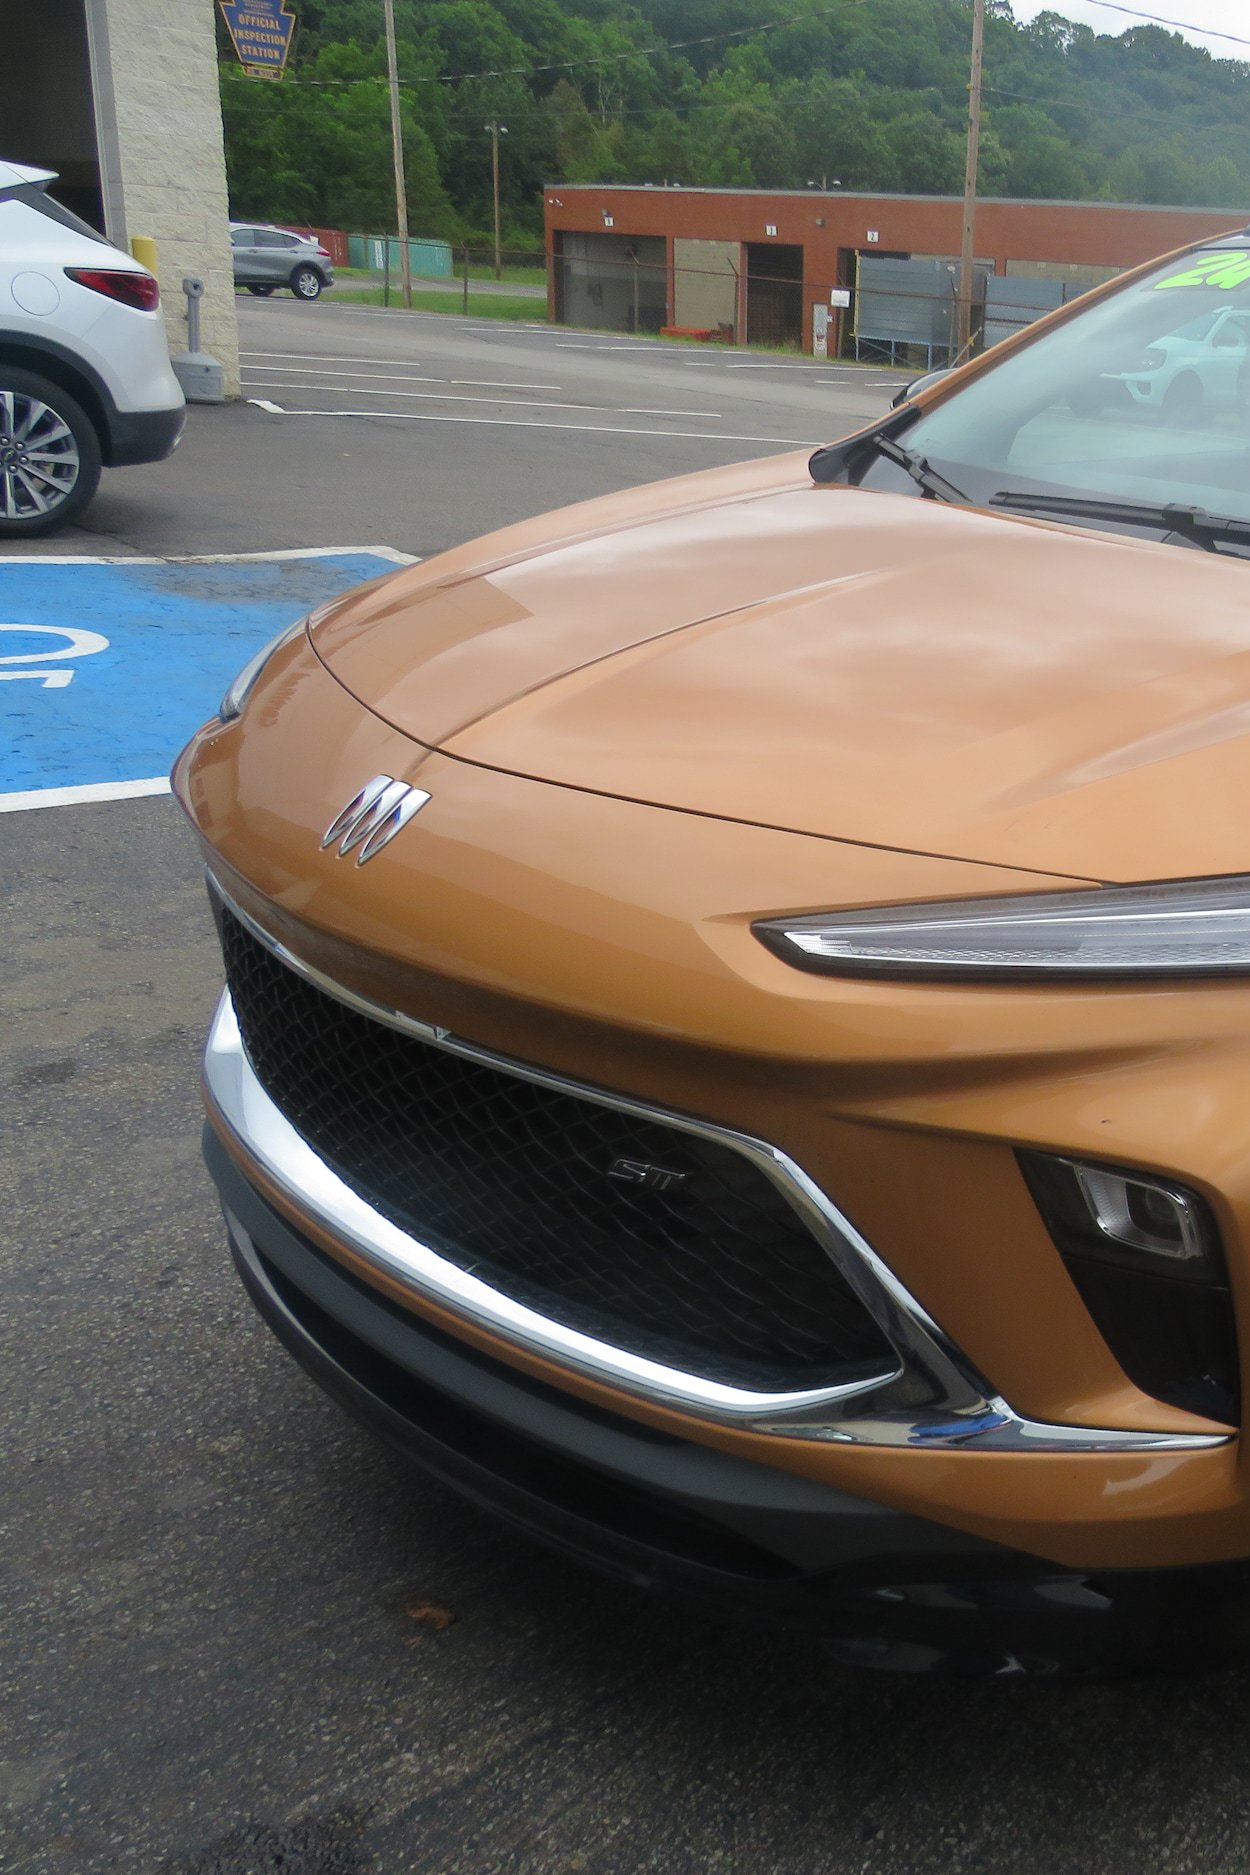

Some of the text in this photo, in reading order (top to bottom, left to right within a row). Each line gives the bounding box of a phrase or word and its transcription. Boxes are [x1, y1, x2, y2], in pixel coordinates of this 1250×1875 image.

[238, 14, 281, 31] OFFICIAL
[233, 28, 287, 47] INSPECTION
[241, 44, 280, 60] STATION
[608, 1158, 686, 1191] ST
